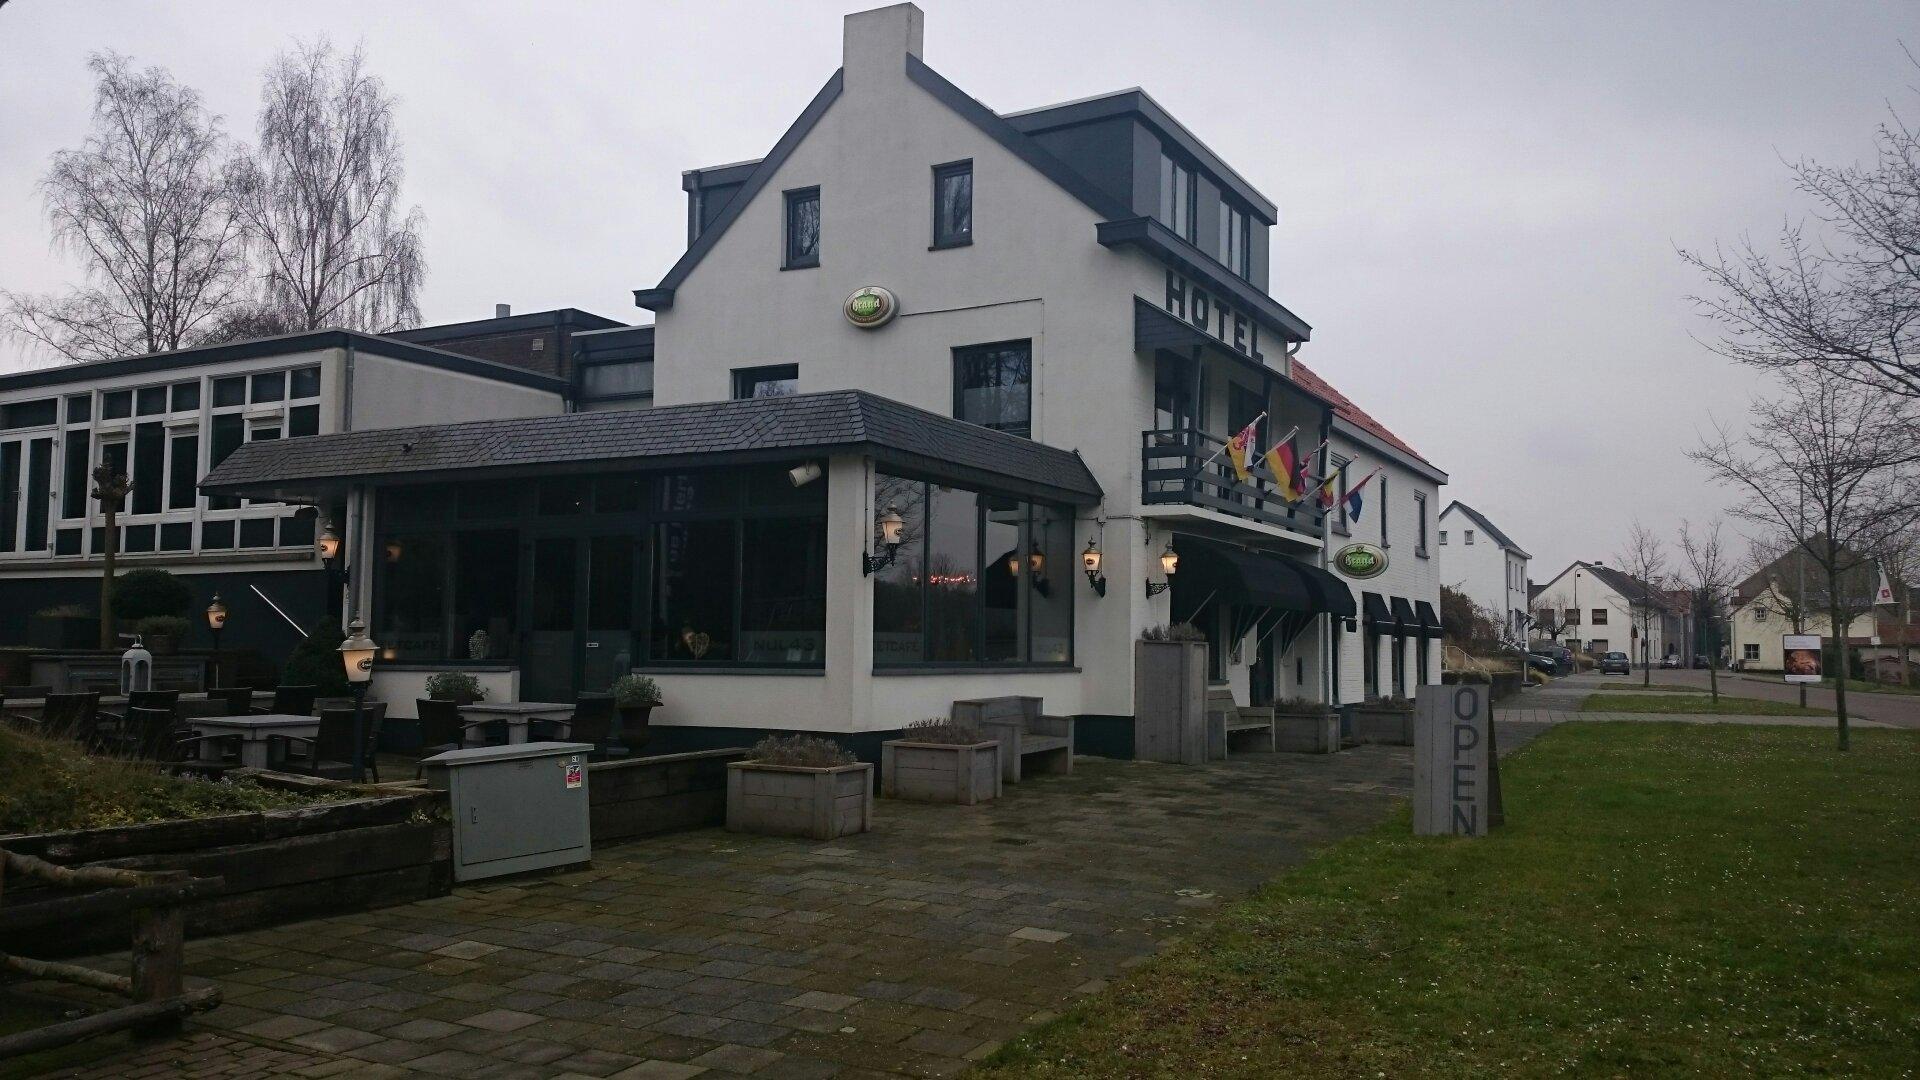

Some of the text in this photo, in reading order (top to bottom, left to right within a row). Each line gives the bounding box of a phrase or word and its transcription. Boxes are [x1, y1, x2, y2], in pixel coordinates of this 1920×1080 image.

[852, 298, 880, 312] Brand
[1166, 269, 1264, 364] HOTEL
[1345, 554, 1374, 566] Brand
[1452, 687, 1479, 835] OPEN
